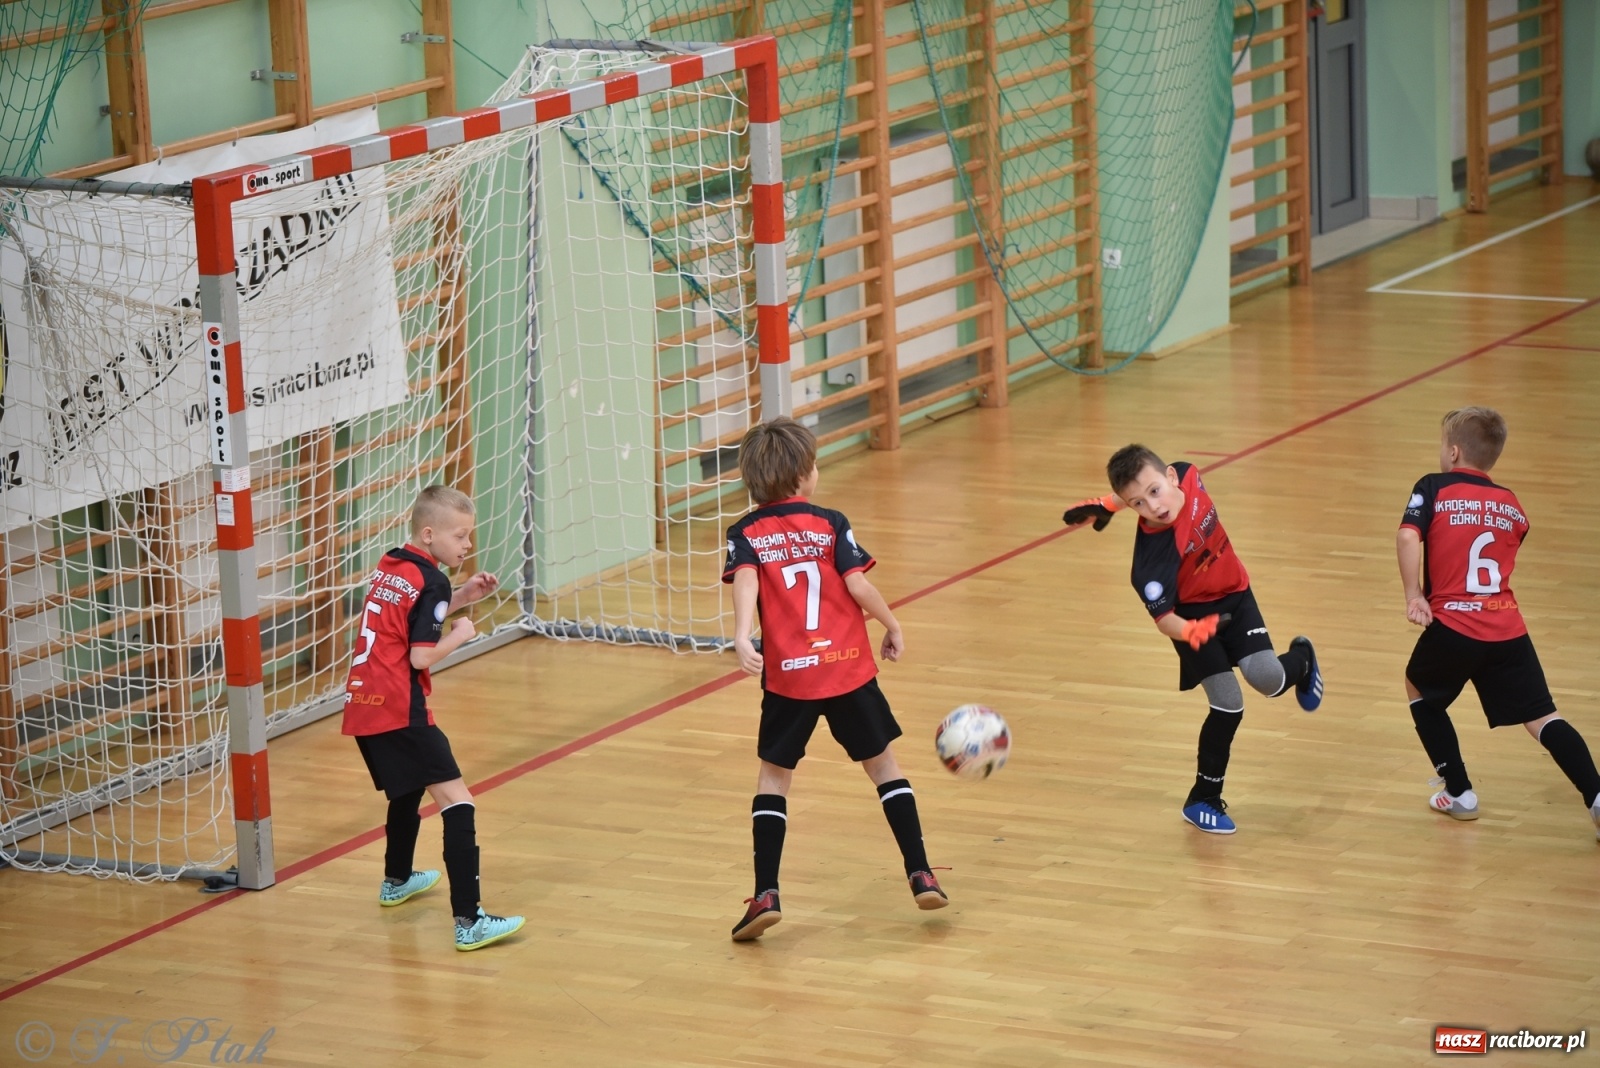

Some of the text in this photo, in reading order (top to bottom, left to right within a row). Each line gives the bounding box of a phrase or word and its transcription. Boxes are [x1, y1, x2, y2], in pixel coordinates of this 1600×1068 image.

[275, 165, 301, 185] sport
[214, 396, 225, 462] sport
[1449, 506, 1481, 525] GÓRKI
[758, 547, 790, 563] GÓRKI
[1466, 530, 1502, 594] 6
[780, 560, 822, 631] 7
[351, 600, 382, 668] 5
[1246, 627, 1267, 636] reg
[781, 648, 860, 672] GER-BUD
